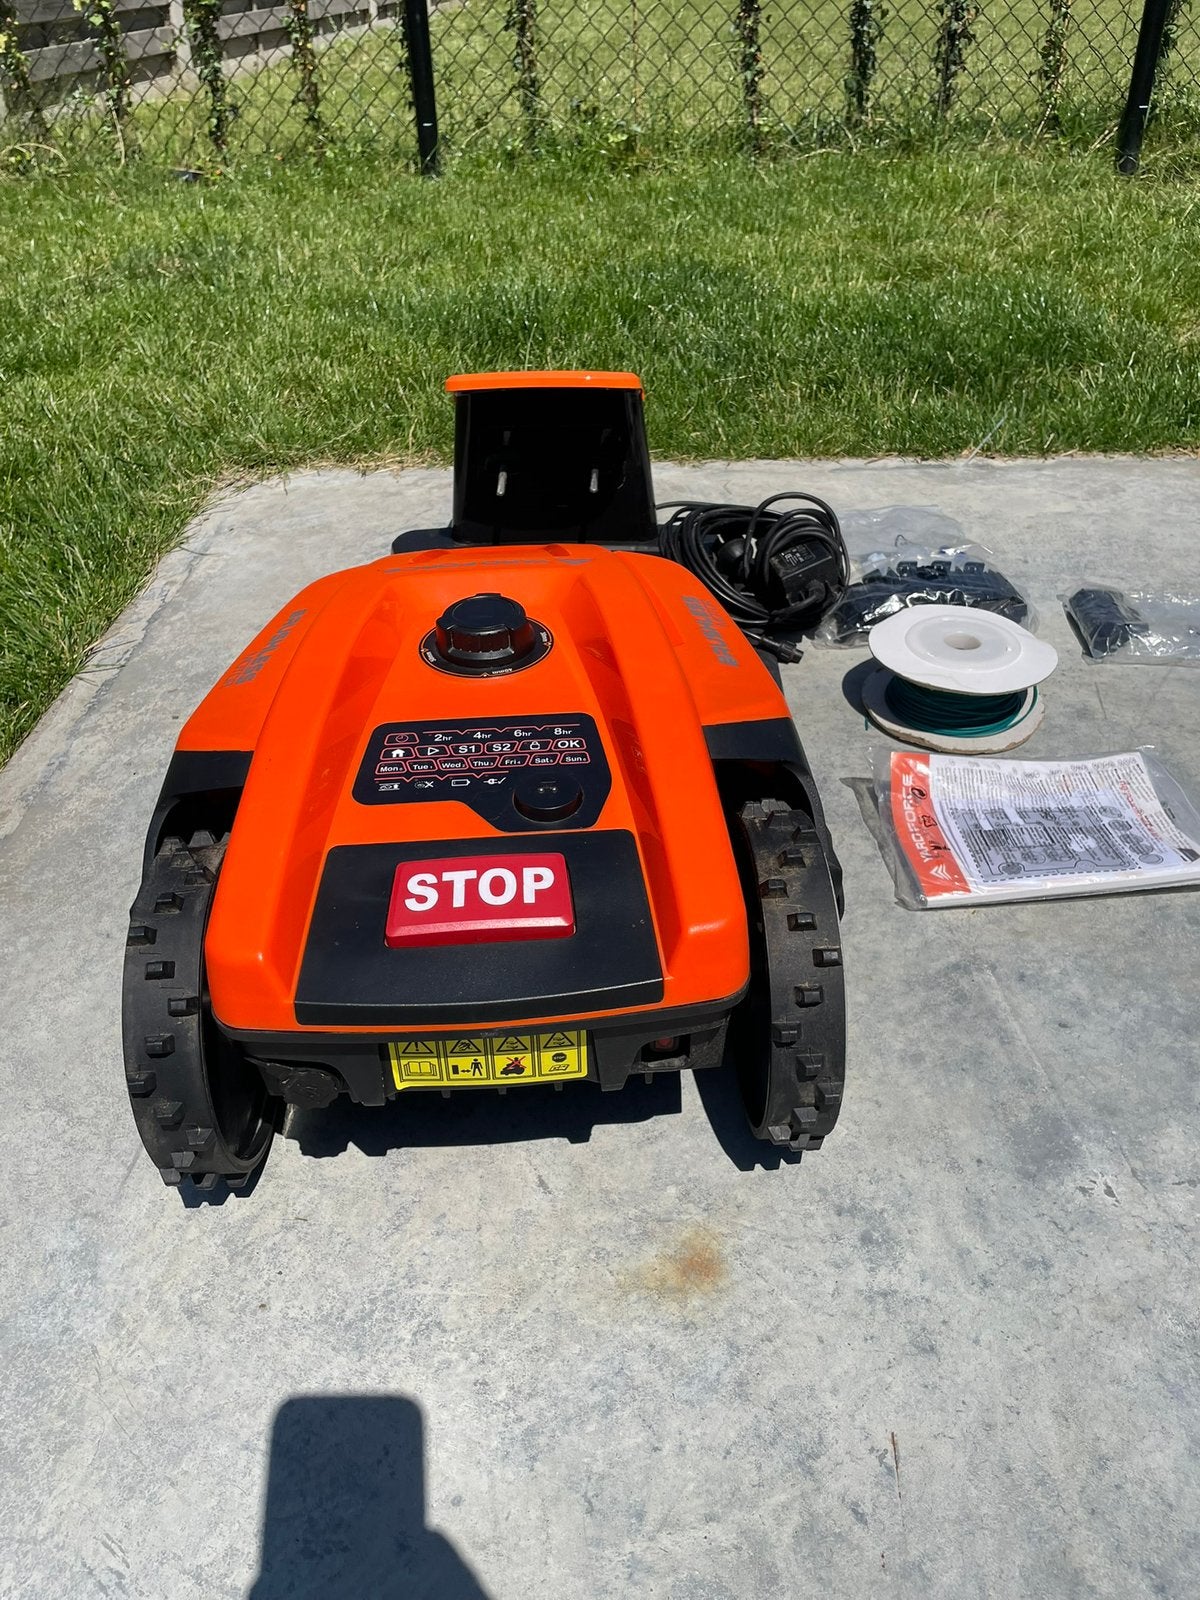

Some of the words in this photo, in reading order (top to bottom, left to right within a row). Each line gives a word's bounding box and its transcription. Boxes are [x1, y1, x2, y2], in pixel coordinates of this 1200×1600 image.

[434, 734, 453, 742] 2hr
[473, 732, 492, 740] 4hr
[513, 729, 532, 737] 6hr
[554, 727, 573, 735] 8hr
[458, 745, 476, 754] S1
[492, 743, 511, 752] S2
[557, 740, 581, 749] OK
[404, 867, 555, 911] STOP
